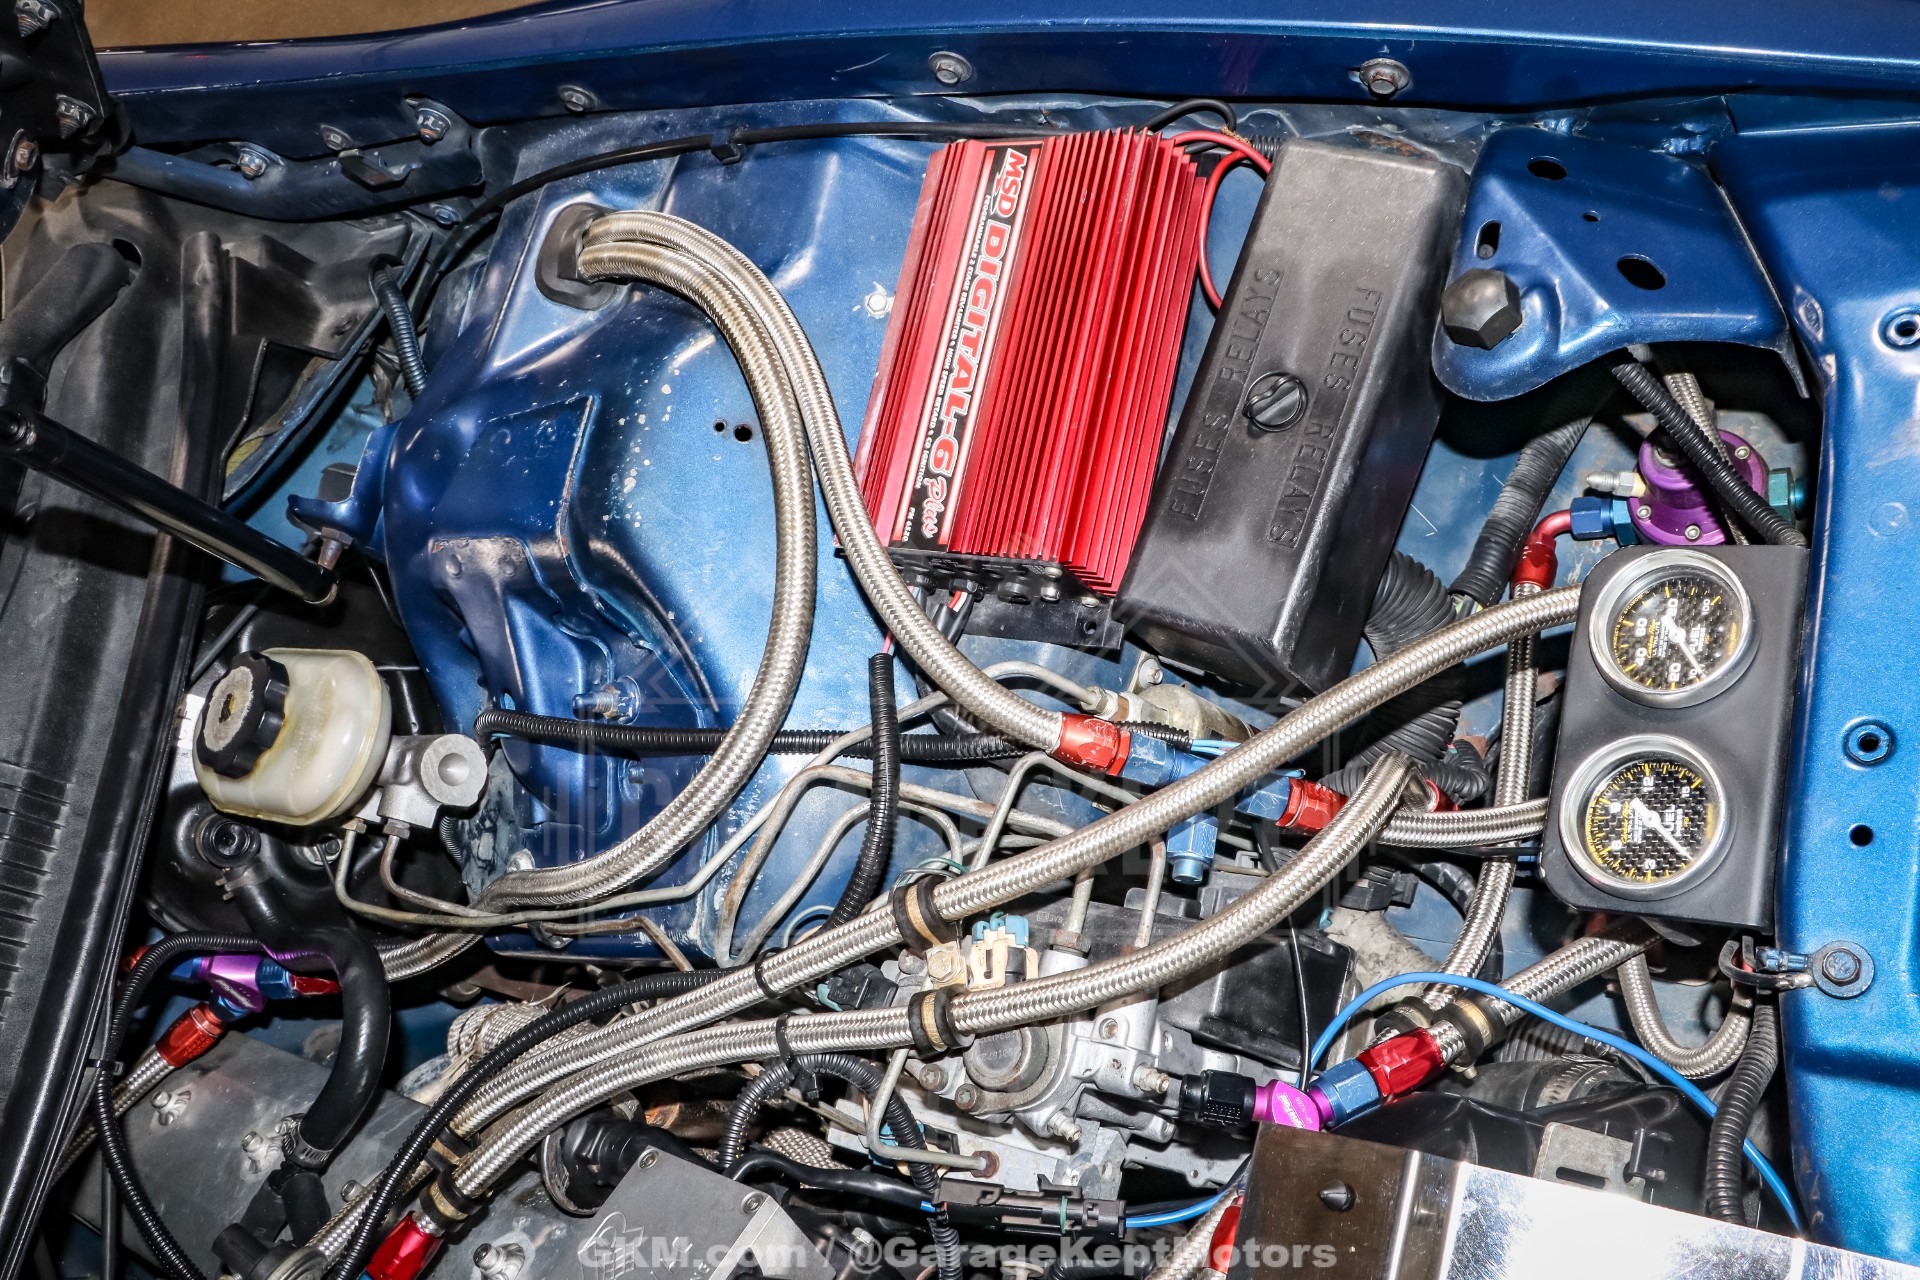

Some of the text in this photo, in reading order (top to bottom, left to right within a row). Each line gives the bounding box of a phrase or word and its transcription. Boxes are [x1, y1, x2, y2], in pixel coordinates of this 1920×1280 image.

[973, 195, 990, 258] PROGRAMMABLE
[965, 265, 973, 290] STAGE
[921, 148, 1028, 539] MSD DIGITAL-6 Plus
[944, 347, 953, 369] HIGH
[939, 369, 948, 395] SPEED
[1169, 266, 1281, 521] FUSES RELAYS
[930, 396, 941, 429] RETARD
[1268, 287, 1384, 543] FUSES RELAYS
[924, 436, 932, 448] CD
[915, 449, 928, 488] IGNITION
[902, 506, 915, 542] PN 6520
[1702, 599, 1711, 615] 100
[1689, 624, 1700, 654] FUEL
[1698, 628, 1706, 651] PRESS
[1635, 648, 1647, 666] 40
[1669, 663, 1681, 682] 20
[1643, 776, 1654, 792] 12
[1675, 809, 1683, 837] PRESS
[1644, 859, 1656, 870] 3
